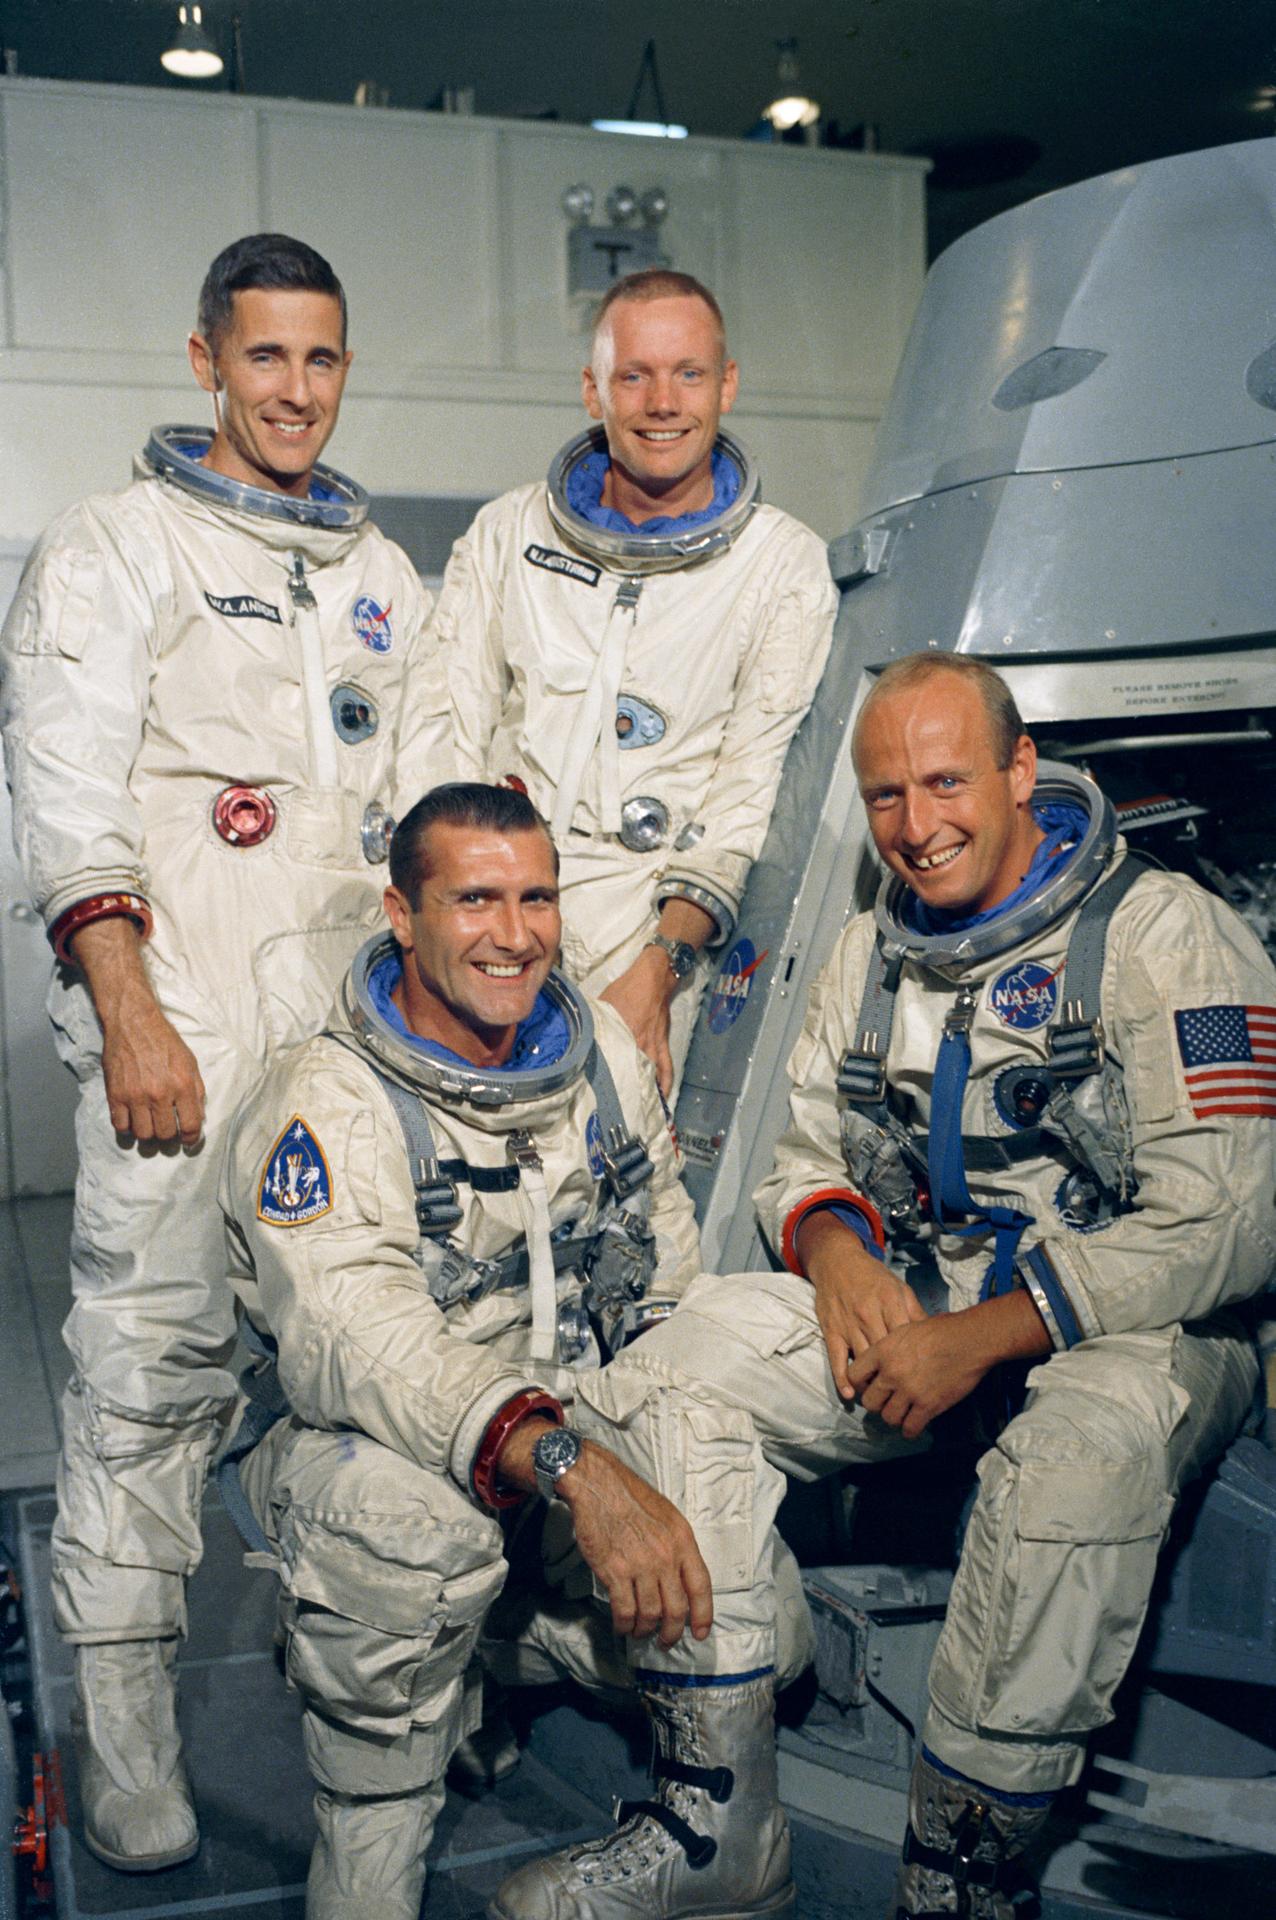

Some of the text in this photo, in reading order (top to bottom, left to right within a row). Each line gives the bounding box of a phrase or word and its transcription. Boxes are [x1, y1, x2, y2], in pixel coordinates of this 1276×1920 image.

[1112, 685, 1153, 693] PLEASE
[1156, 682, 1201, 691] REMOVE
[1126, 697, 1167, 705] BEFORE
[714, 974, 750, 998] NASA
[995, 986, 1053, 1006] NASA
[262, 1198, 329, 1221] CONRAD GORDON
